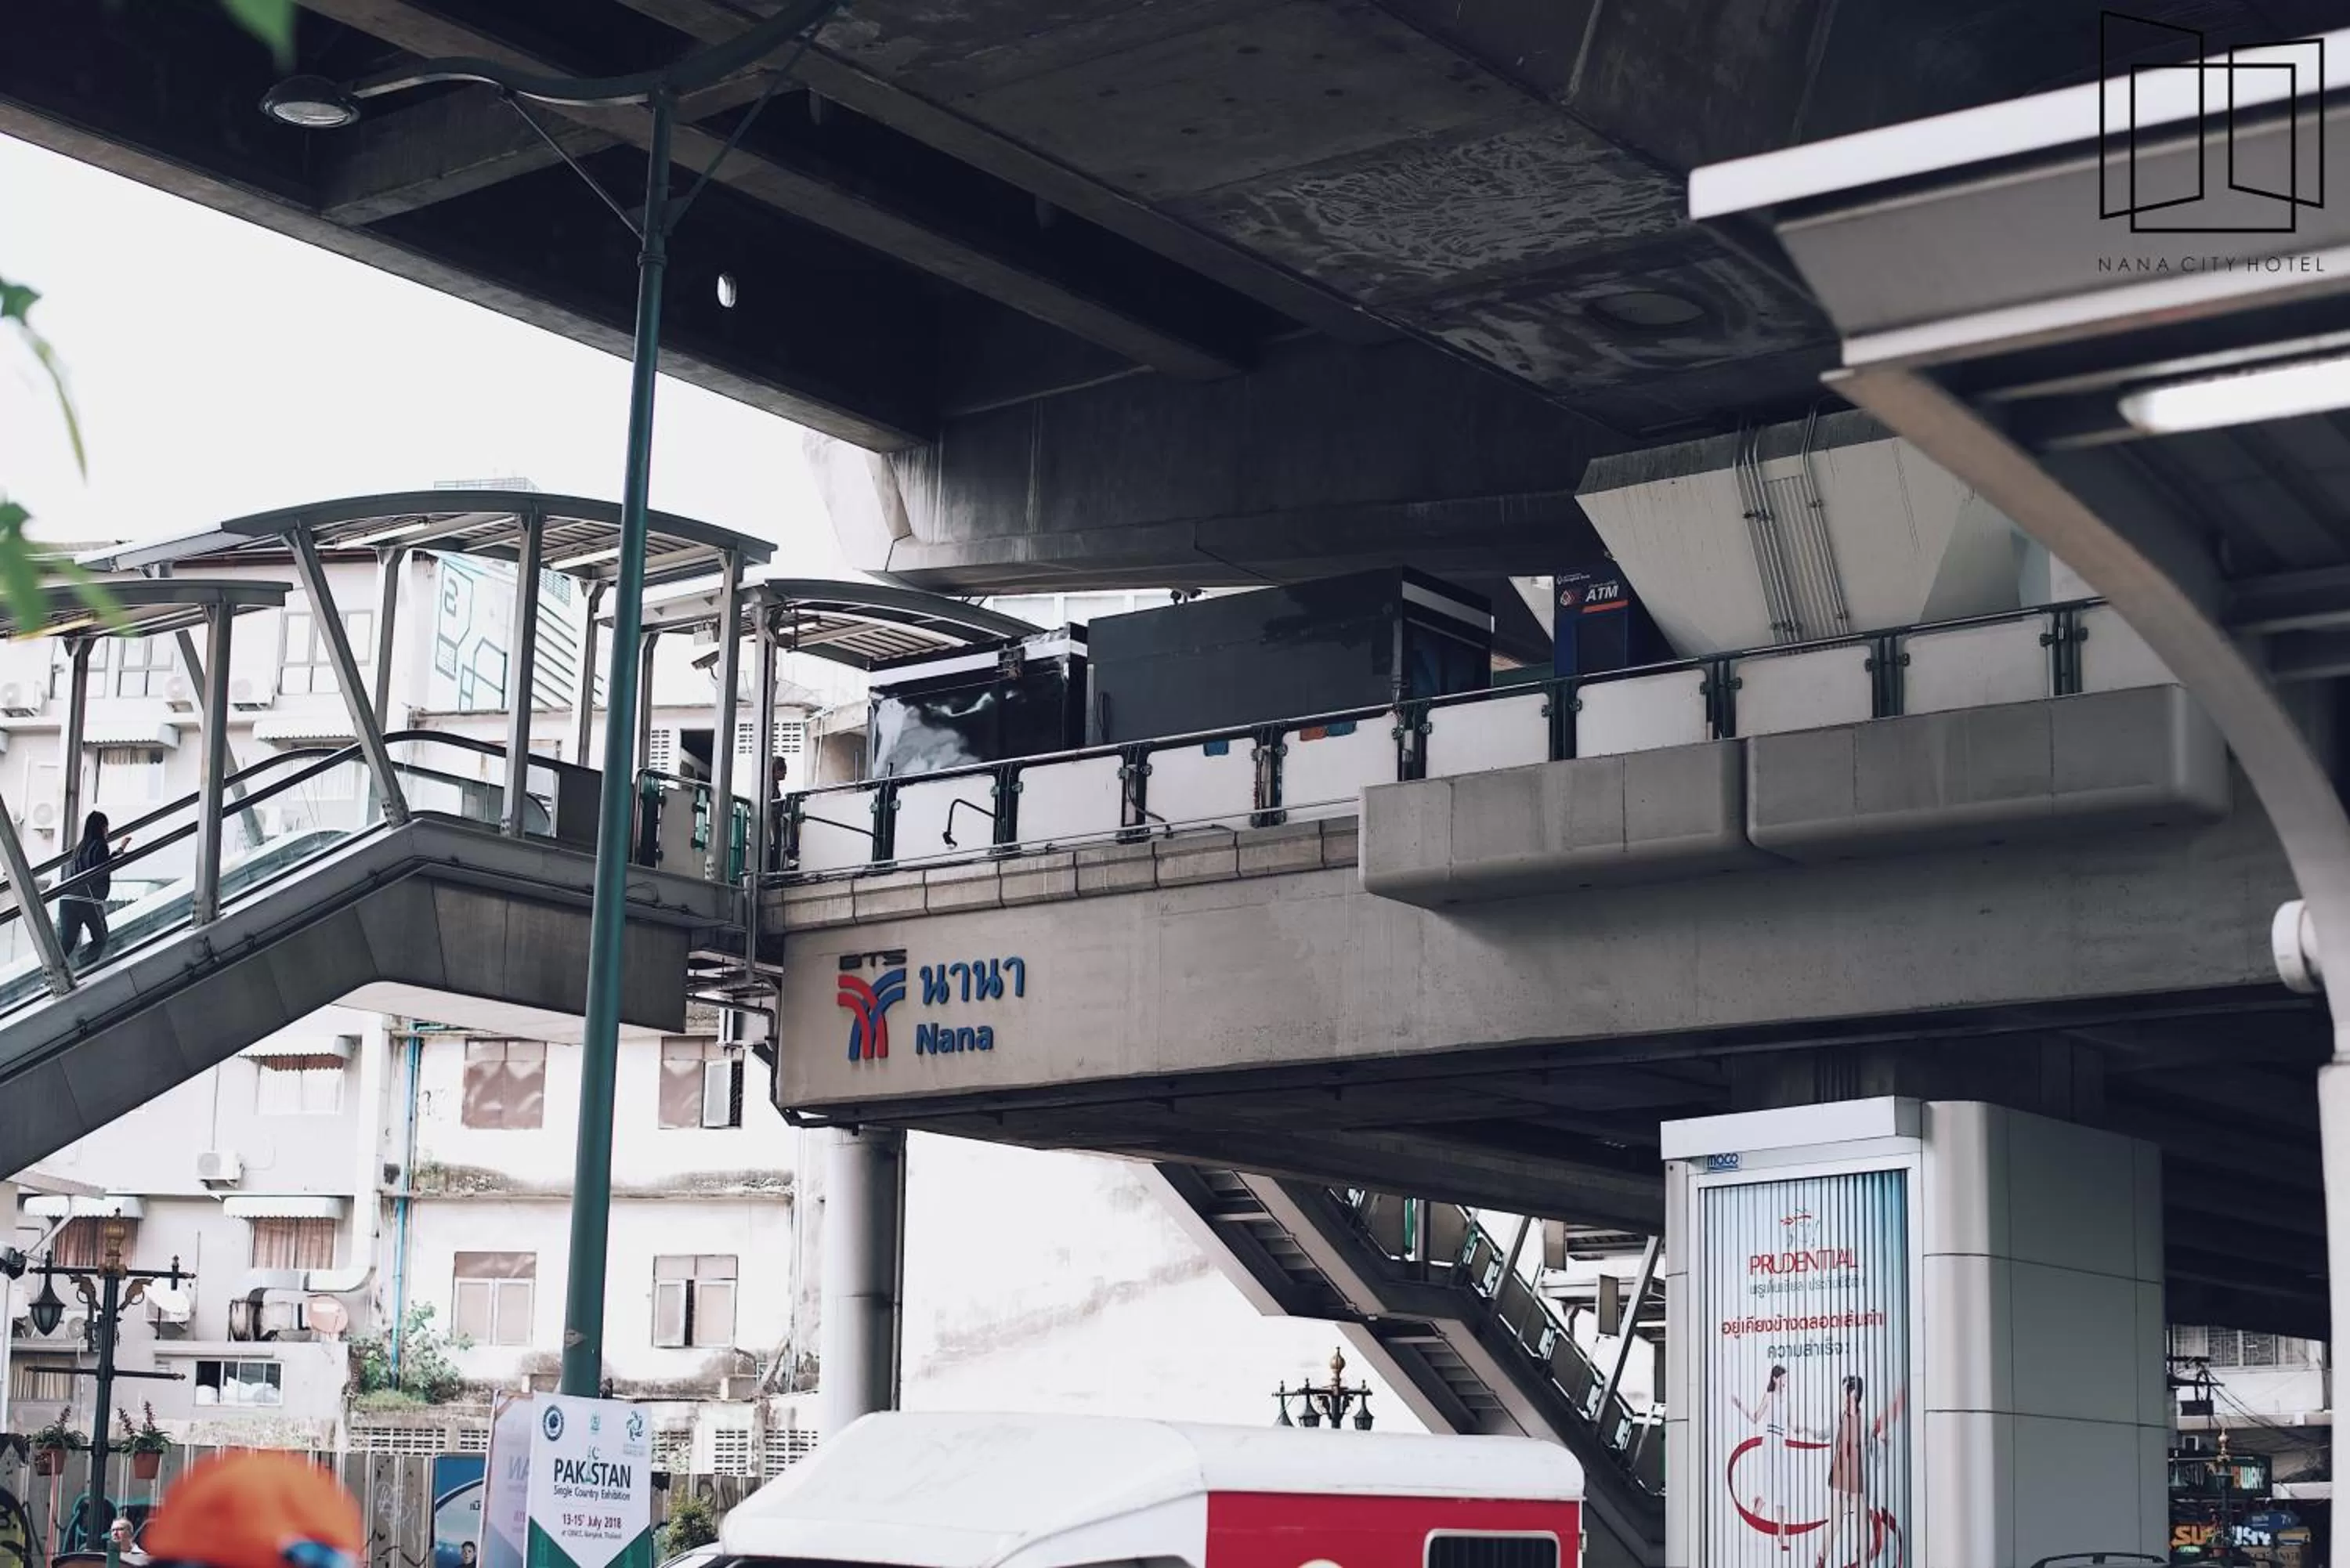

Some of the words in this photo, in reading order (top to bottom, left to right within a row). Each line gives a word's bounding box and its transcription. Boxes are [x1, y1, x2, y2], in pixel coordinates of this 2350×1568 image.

[1585, 585, 1619, 602] ATM
[920, 956, 1025, 1005] นานา
[916, 1023, 994, 1056] Nana
[1749, 1248, 1859, 1276] PRUDENTIAL
[554, 1485, 573, 1498] Single
[574, 1487, 599, 1501] Country
[601, 1490, 631, 1501] Exhibition
[588, 1516, 602, 1530] July
[605, 1516, 621, 1529] 2018
